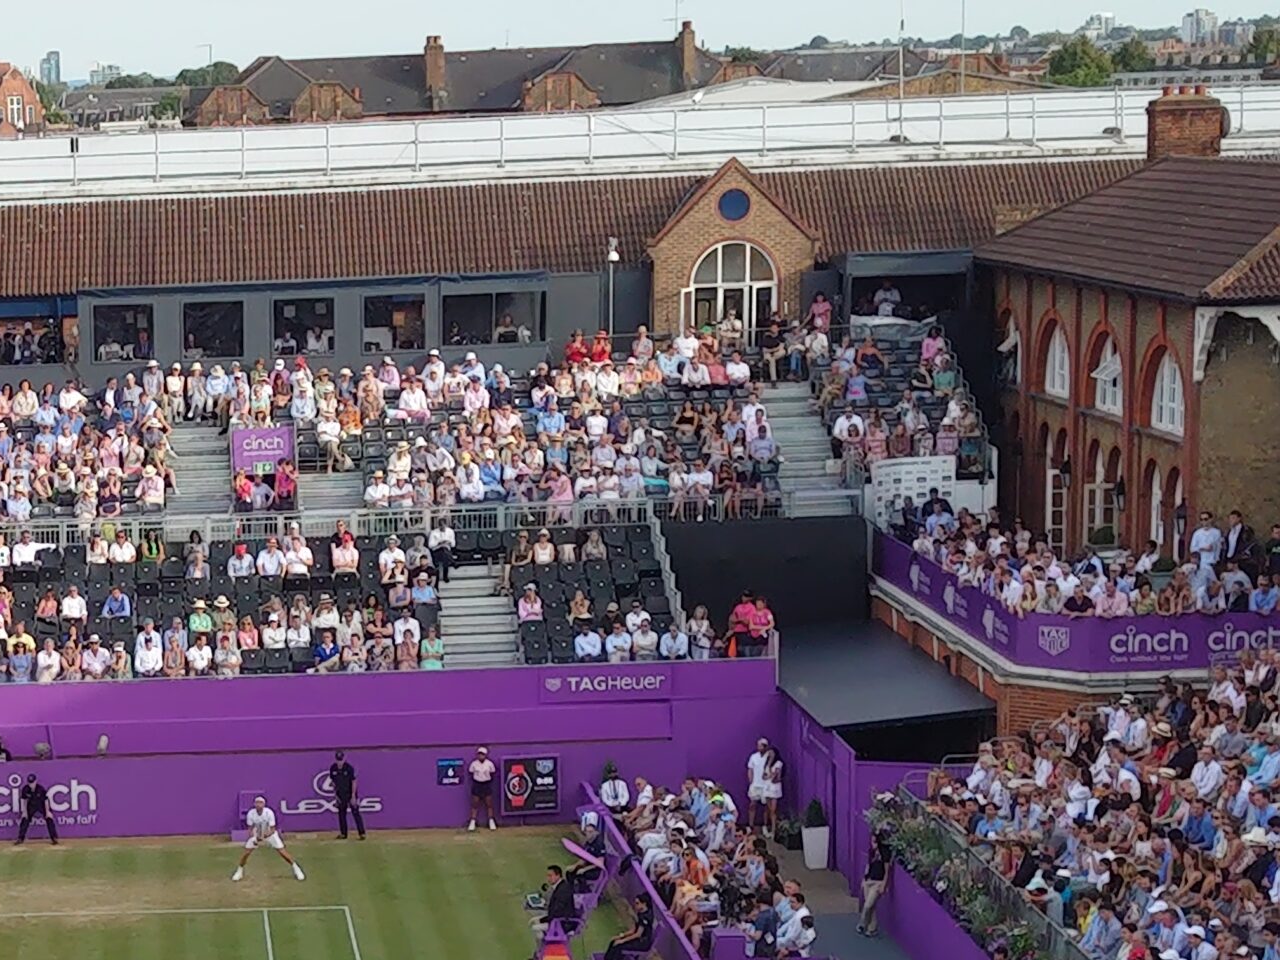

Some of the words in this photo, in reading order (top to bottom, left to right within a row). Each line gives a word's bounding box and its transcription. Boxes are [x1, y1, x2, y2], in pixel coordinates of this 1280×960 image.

[243, 434, 284, 450] cinch
[1110, 625, 1189, 653] cinch
[281, 797, 382, 814] LEXS
